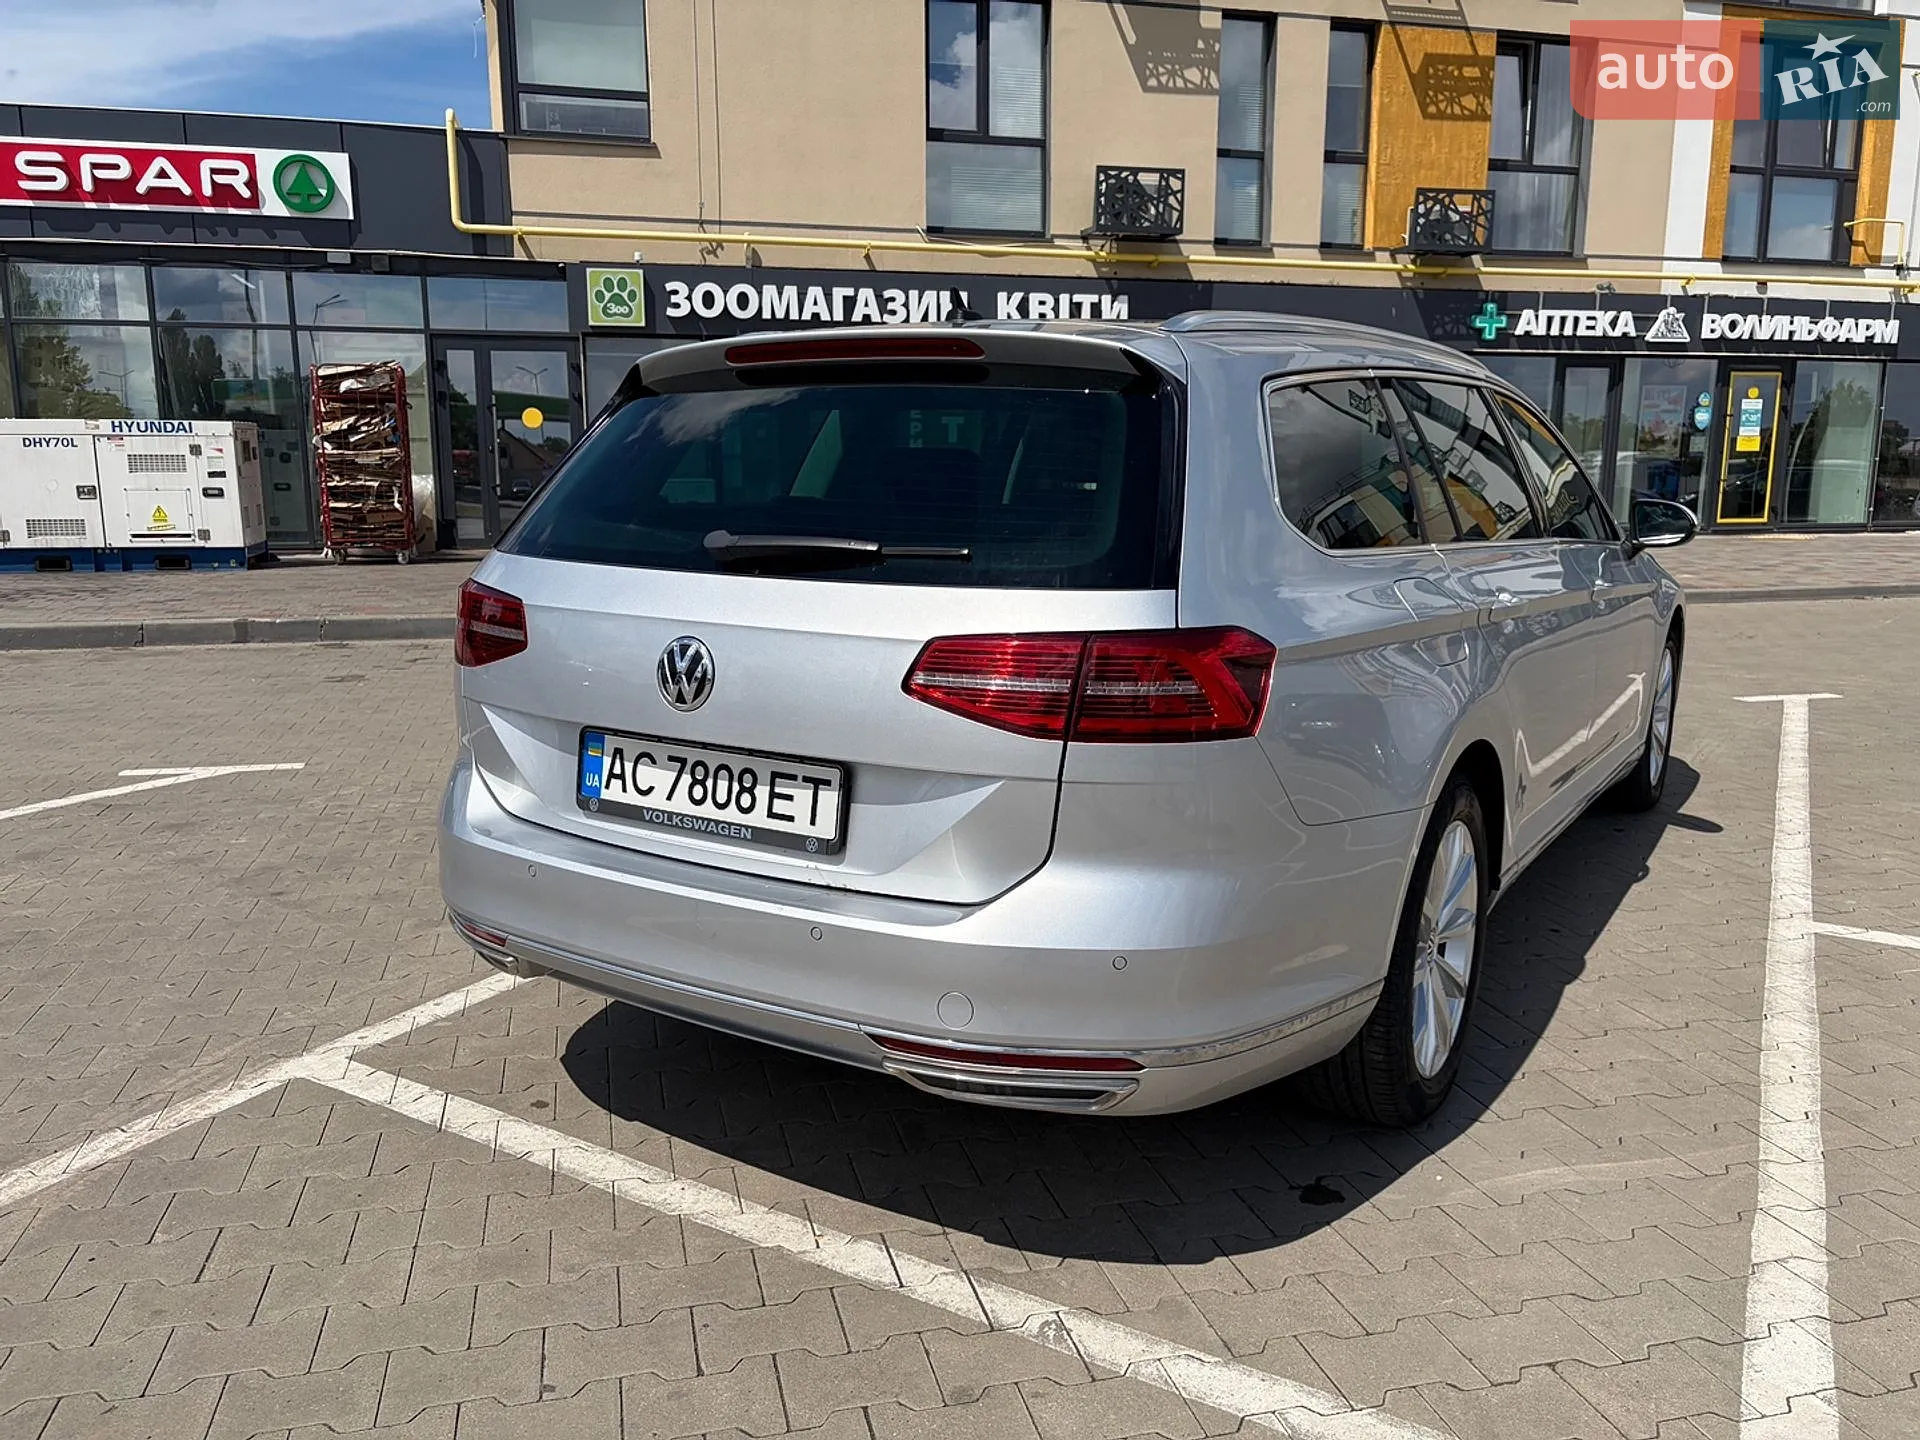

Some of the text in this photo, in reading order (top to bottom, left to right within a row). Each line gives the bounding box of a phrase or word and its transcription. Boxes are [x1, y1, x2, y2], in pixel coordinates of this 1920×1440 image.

[14, 150, 252, 199] SPAR
[997, 291, 1129, 320] КВІТИ
[1514, 309, 1900, 344] АПТЕКА ВОЛИНЬФАРМ
[111, 420, 193, 434] HYUNDAI
[22, 437, 78, 448] DHY70L
[586, 772, 600, 788] UA
[604, 746, 833, 827] AC 7808 ET
[642, 808, 752, 840] VOLKSWAGEN
